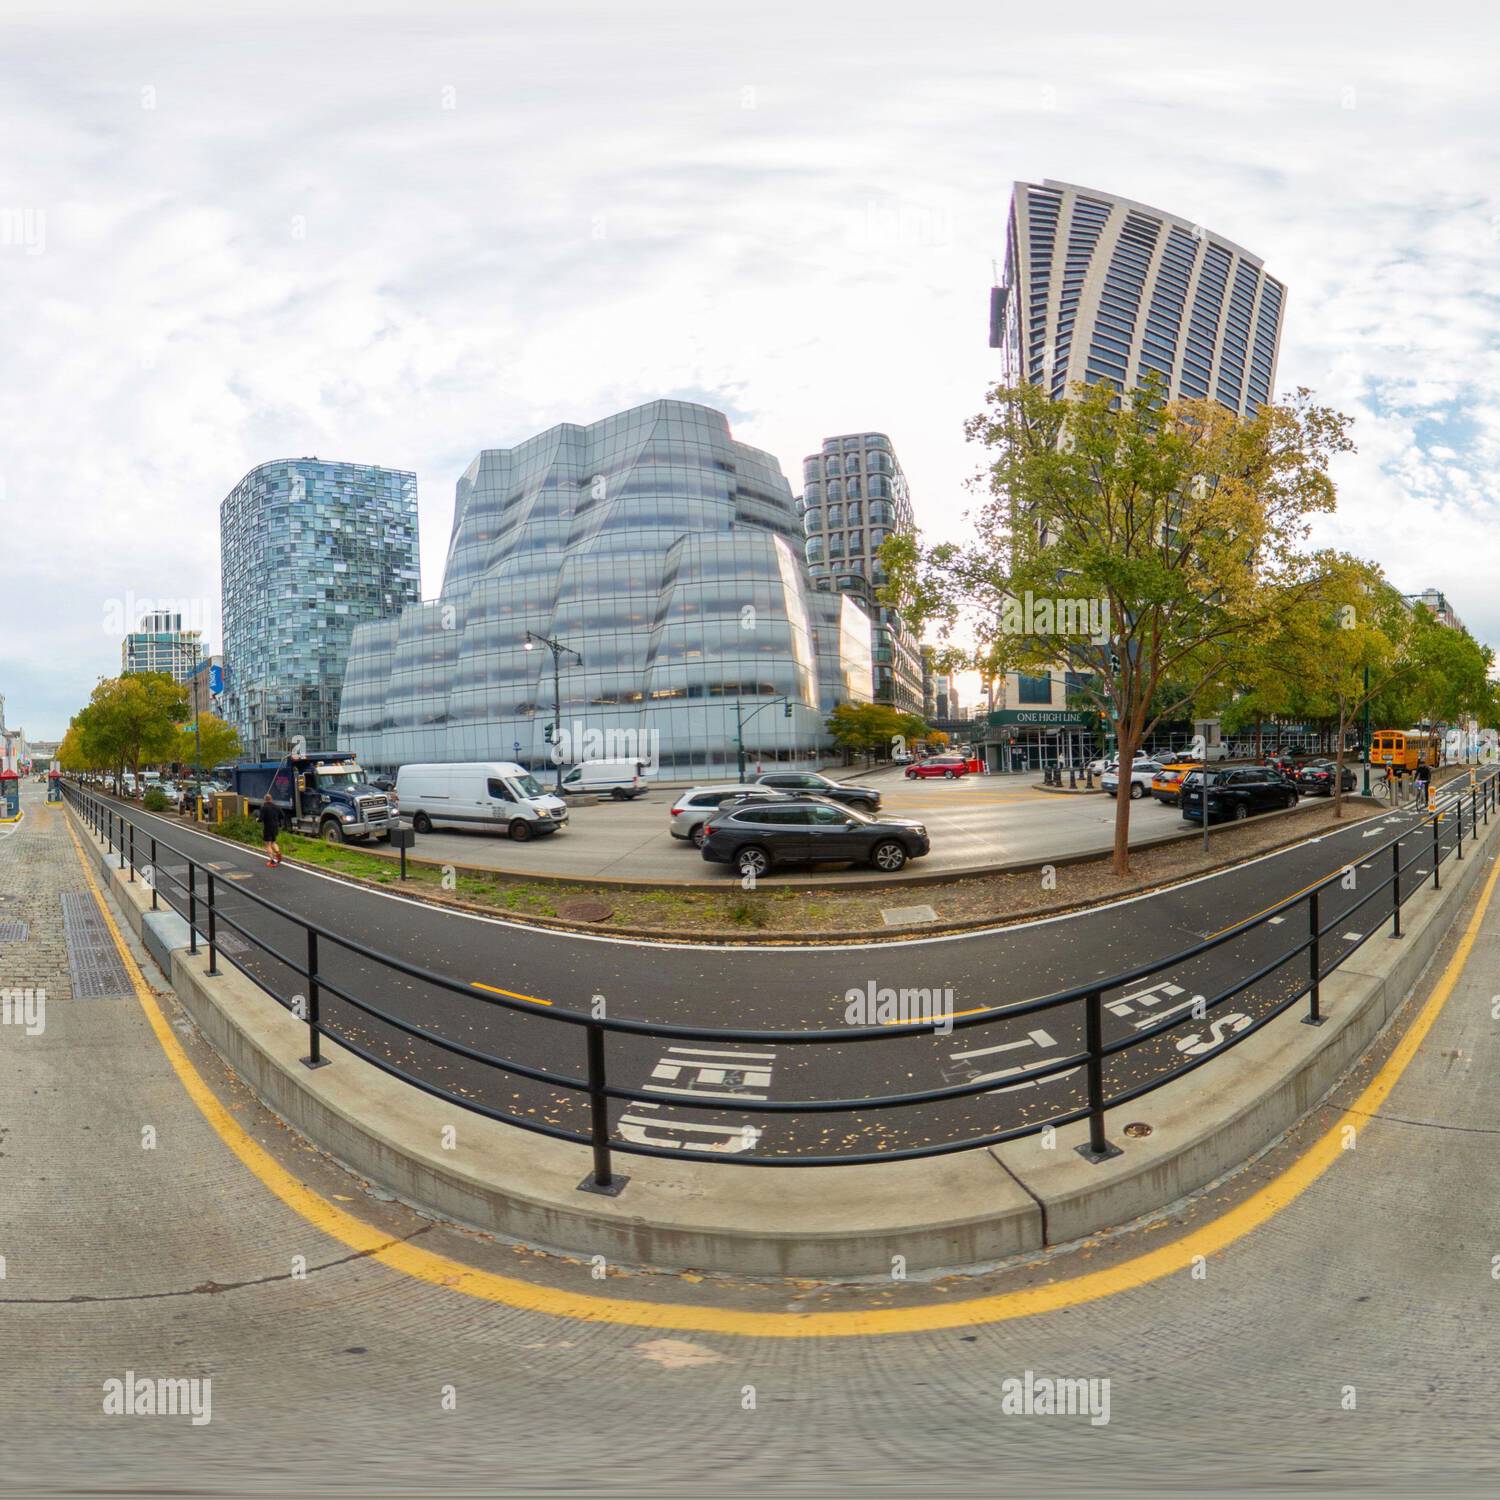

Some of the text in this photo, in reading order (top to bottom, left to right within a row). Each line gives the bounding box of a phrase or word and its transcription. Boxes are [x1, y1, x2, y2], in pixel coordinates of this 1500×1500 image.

[1017, 712, 1081, 722] ONE HIGH LINE
